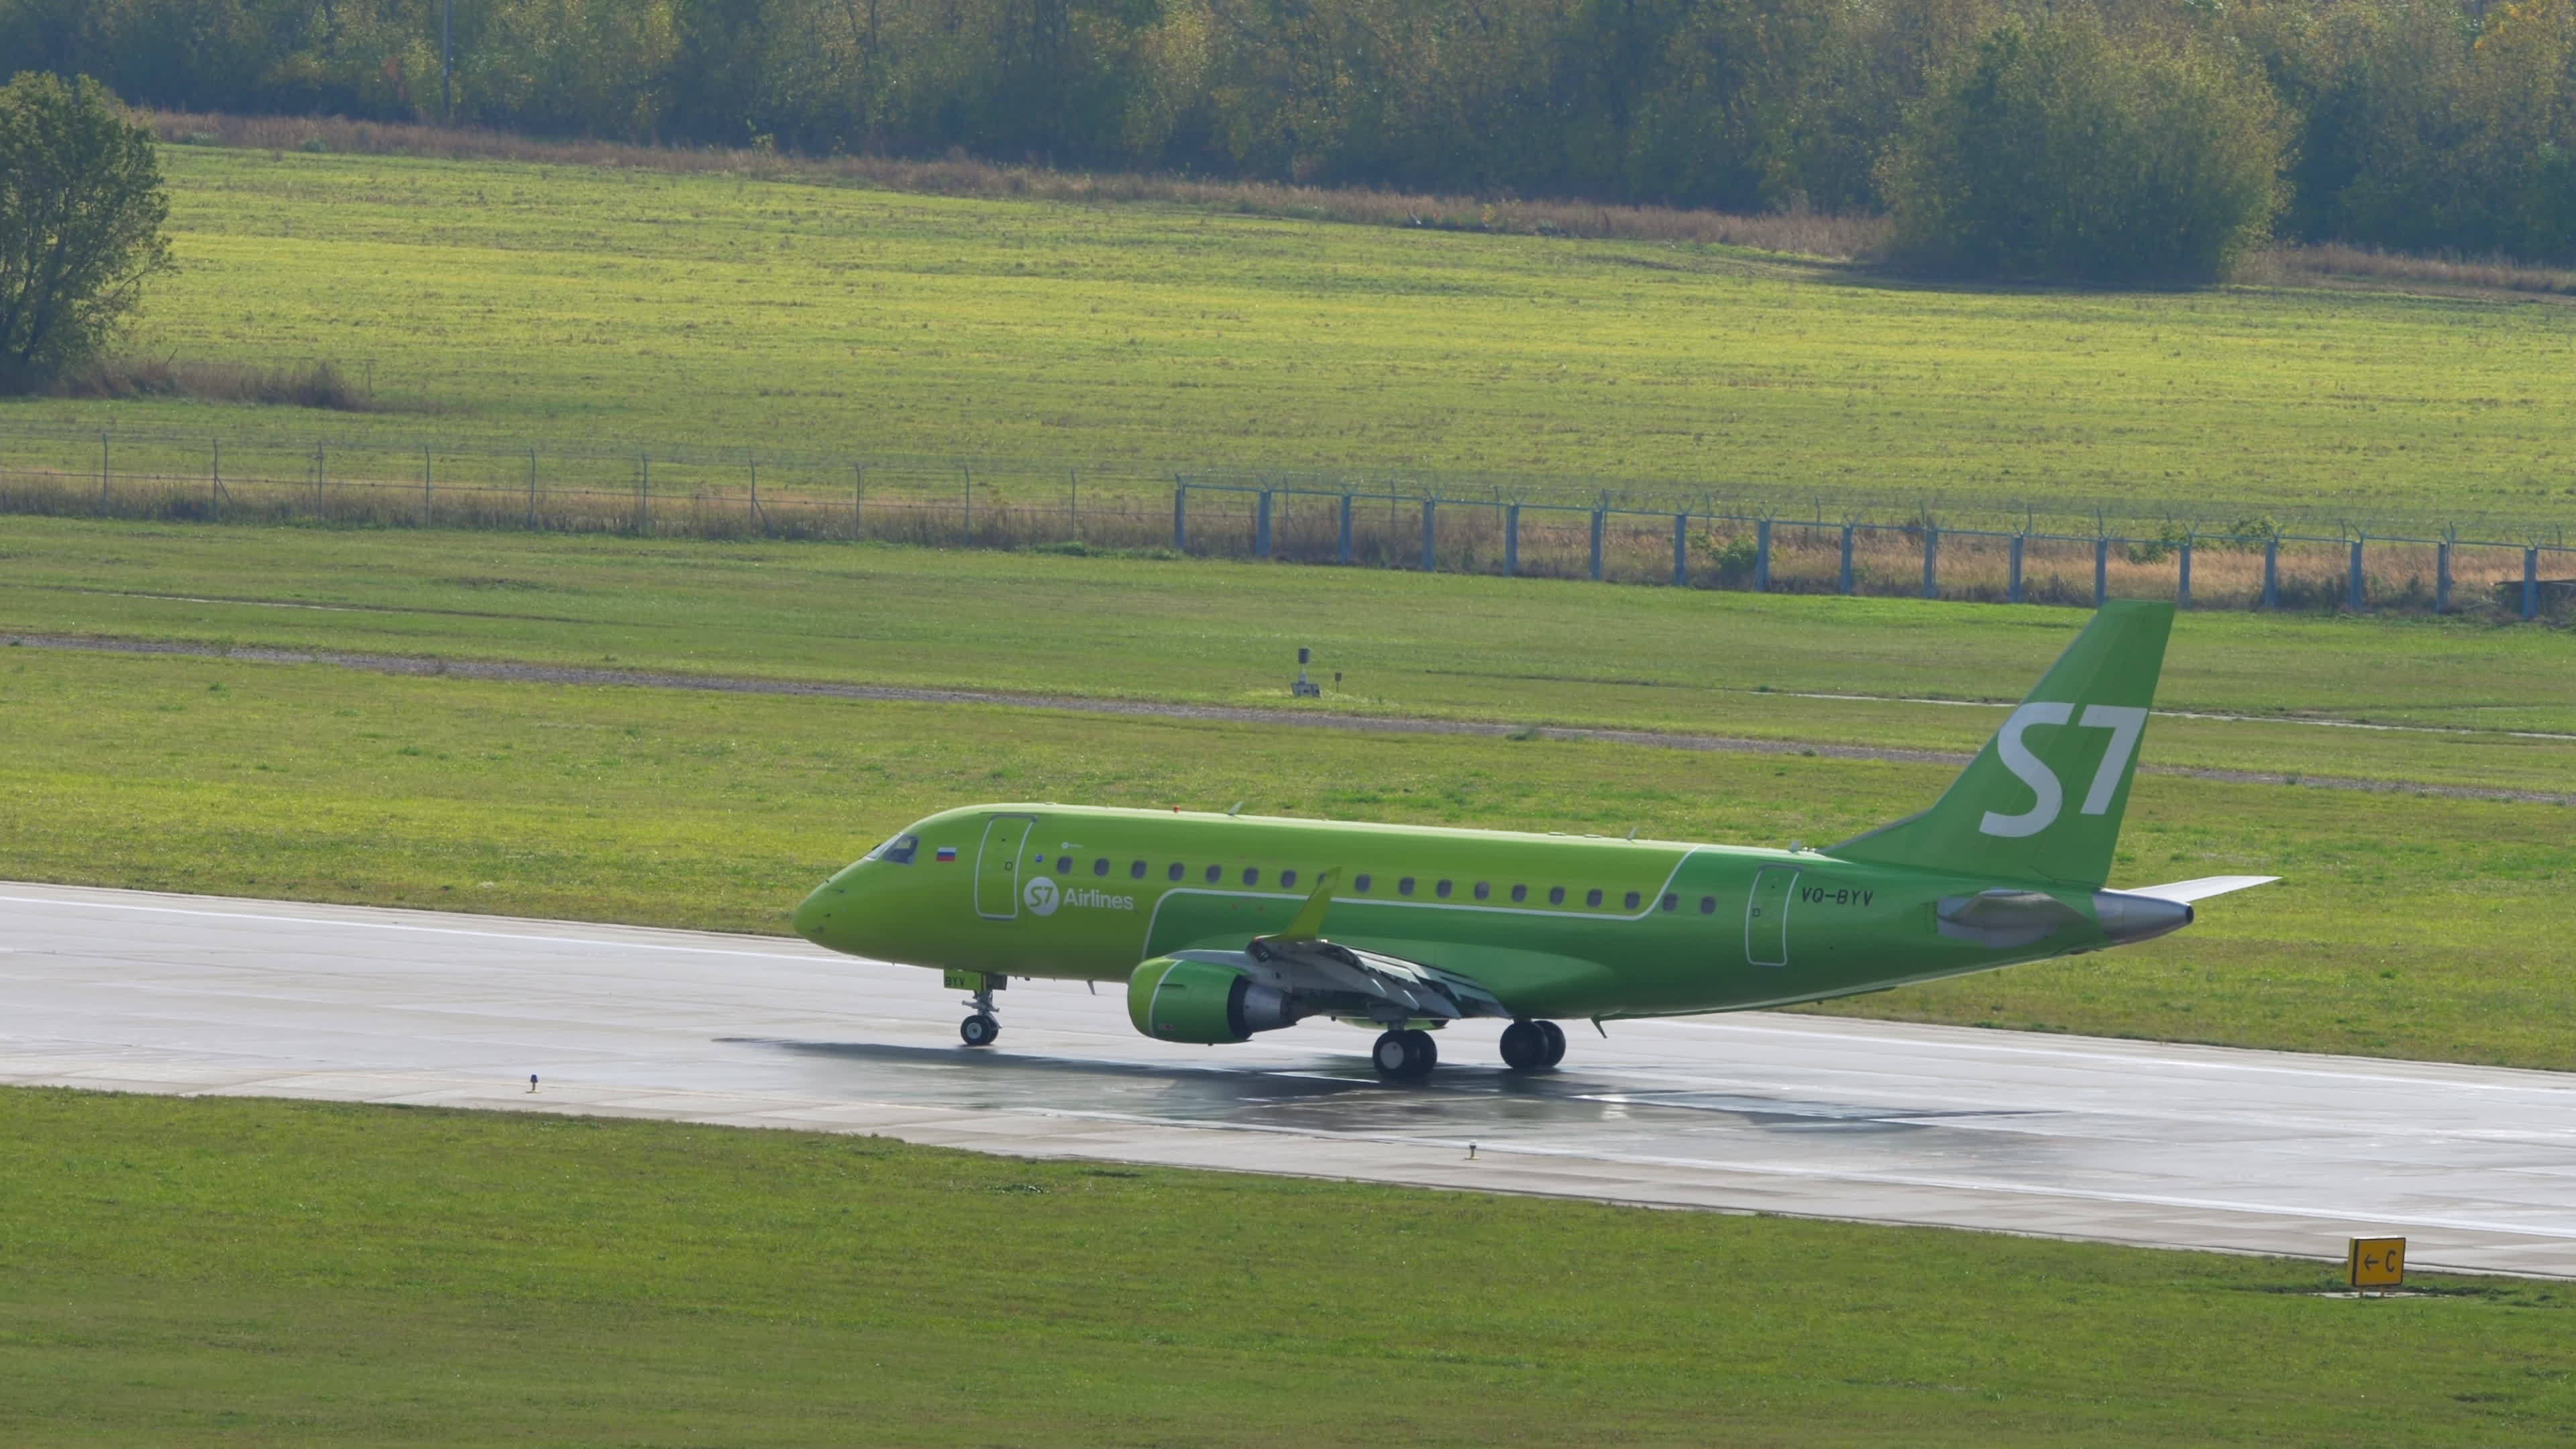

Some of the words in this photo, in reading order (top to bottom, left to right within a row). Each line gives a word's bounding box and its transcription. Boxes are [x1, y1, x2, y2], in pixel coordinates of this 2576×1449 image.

[1979, 702, 2149, 838] S7
[1029, 885, 1053, 907] S7
[1063, 888, 1134, 910] Airlines
[1802, 887, 1874, 906] VQ-BYV
[2385, 1250, 2396, 1273] C
